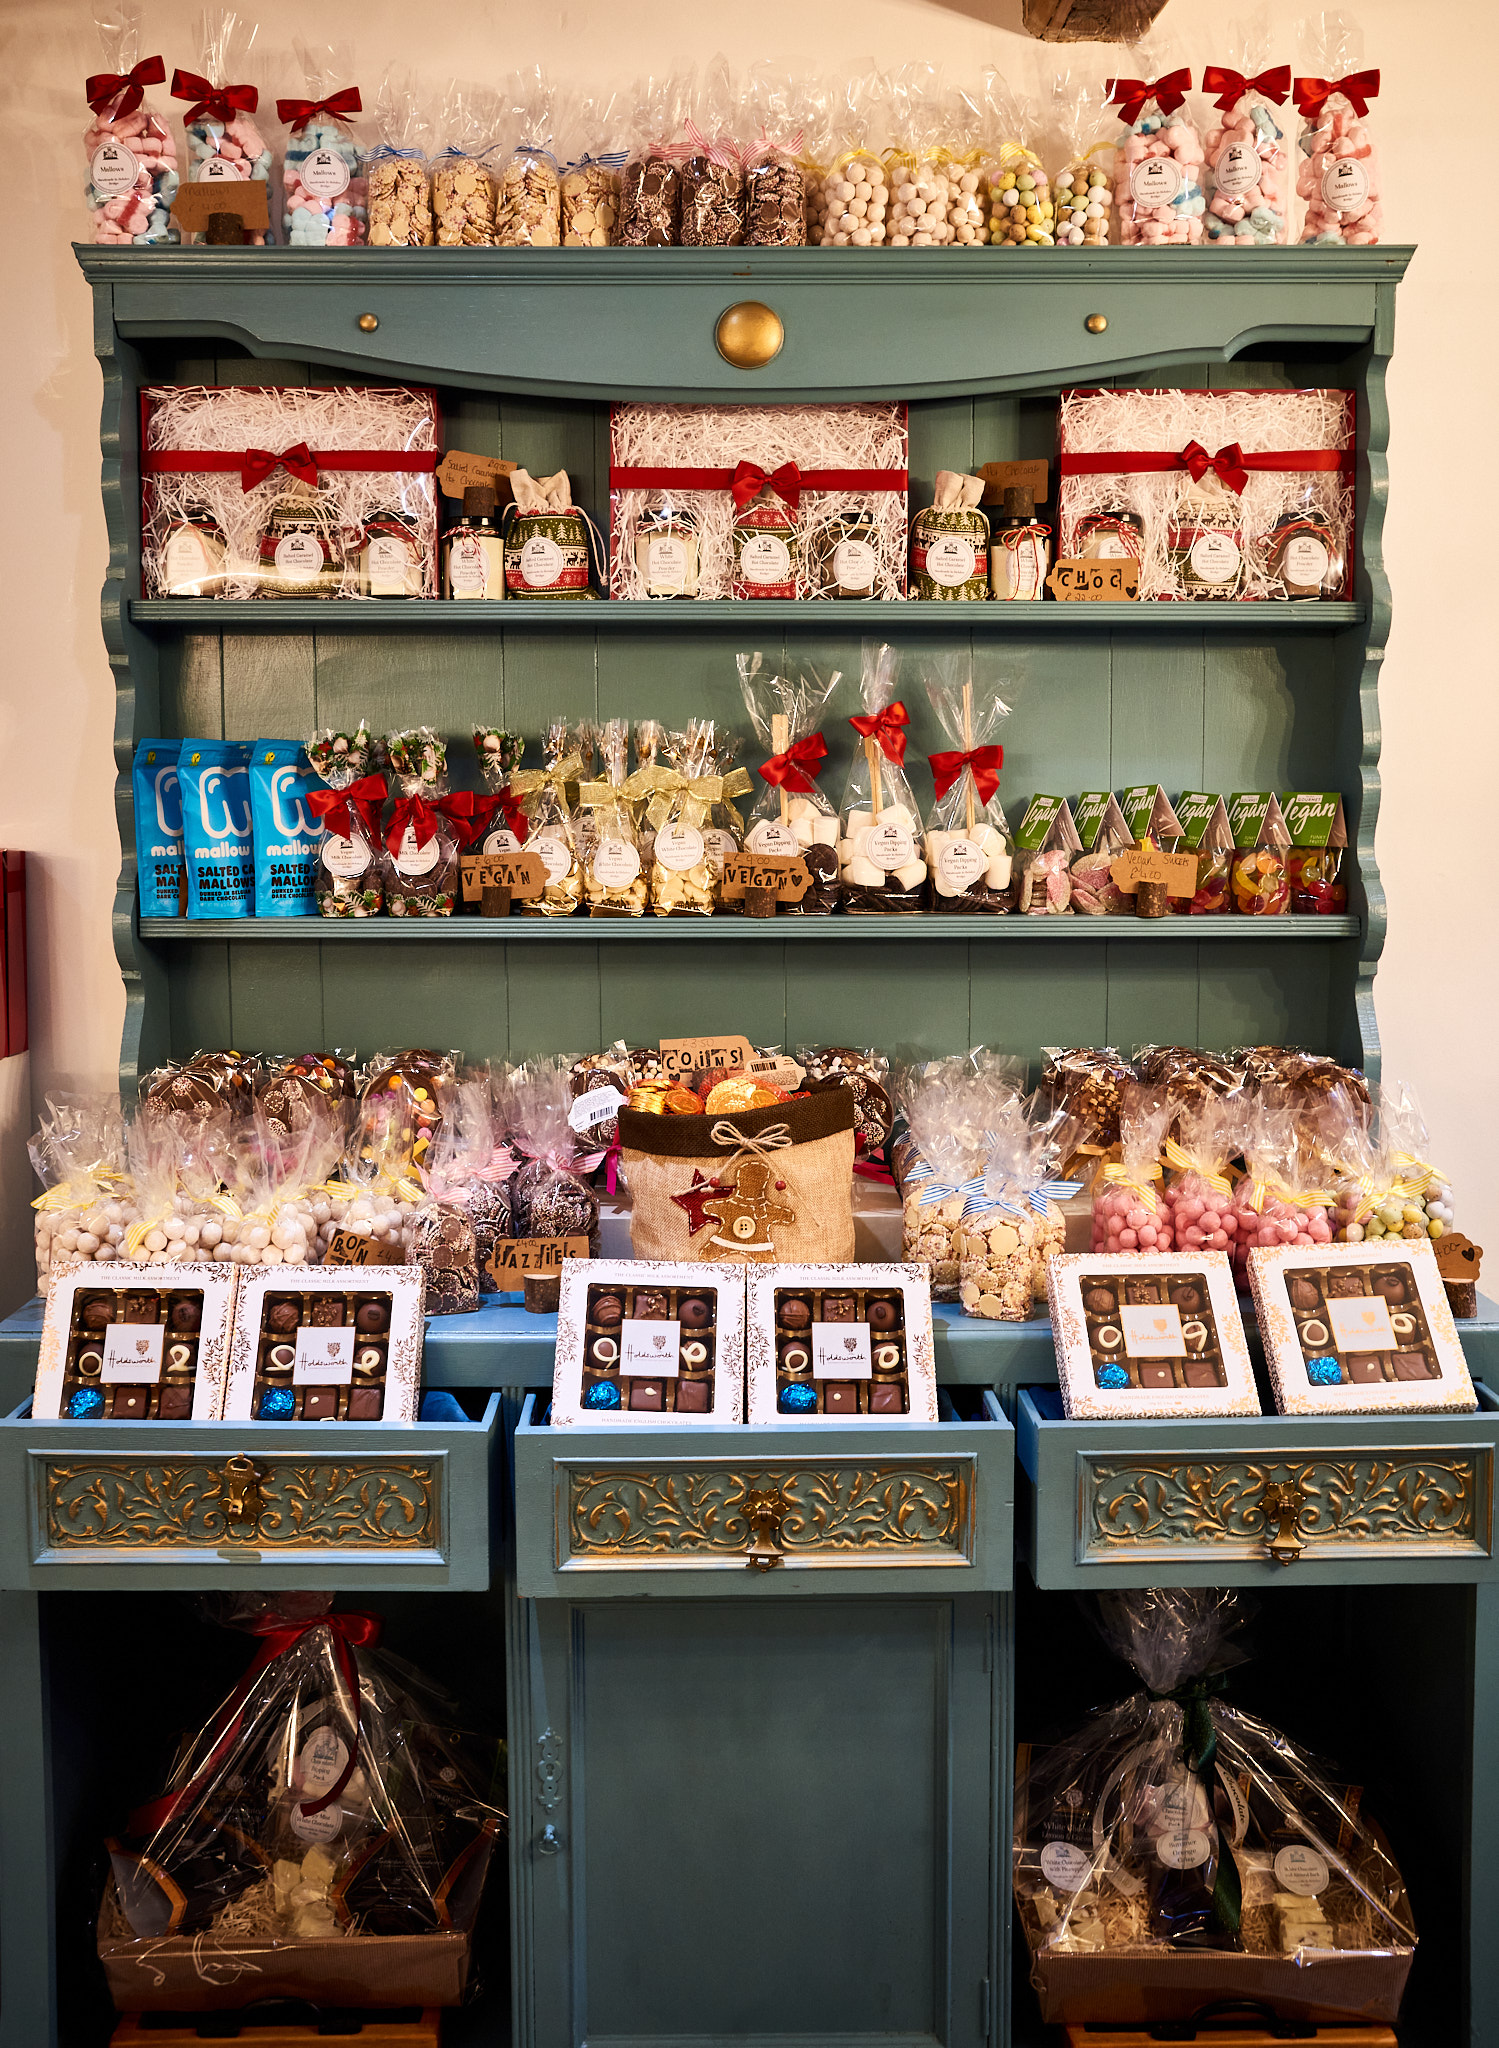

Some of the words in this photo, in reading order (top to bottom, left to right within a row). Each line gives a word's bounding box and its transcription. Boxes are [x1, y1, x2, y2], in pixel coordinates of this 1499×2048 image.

[1225, 166, 1248, 174] Mallows
[1061, 570, 1118, 589] CHOC
[1020, 799, 1058, 837] Vegan
[1073, 797, 1108, 835] Vegan
[1121, 792, 1155, 828] Vegan
[1175, 796, 1215, 831] Vegan
[1228, 798, 1268, 836] Vegan
[1283, 797, 1336, 836] Vegan
[195, 841, 250, 859] mallow
[270, 863, 311, 876] SALTED
[1126, 852, 1157, 869] Vegan
[198, 865, 240, 878] SALTED
[464, 870, 531, 886] VEGAN
[727, 869, 788, 890] VEGAN
[199, 877, 255, 890] MALLOWS
[333, 1236, 369, 1265] BON
[817, 1346, 867, 1365] Holdsworth
[311, 1819, 335, 1828] Chocolate
